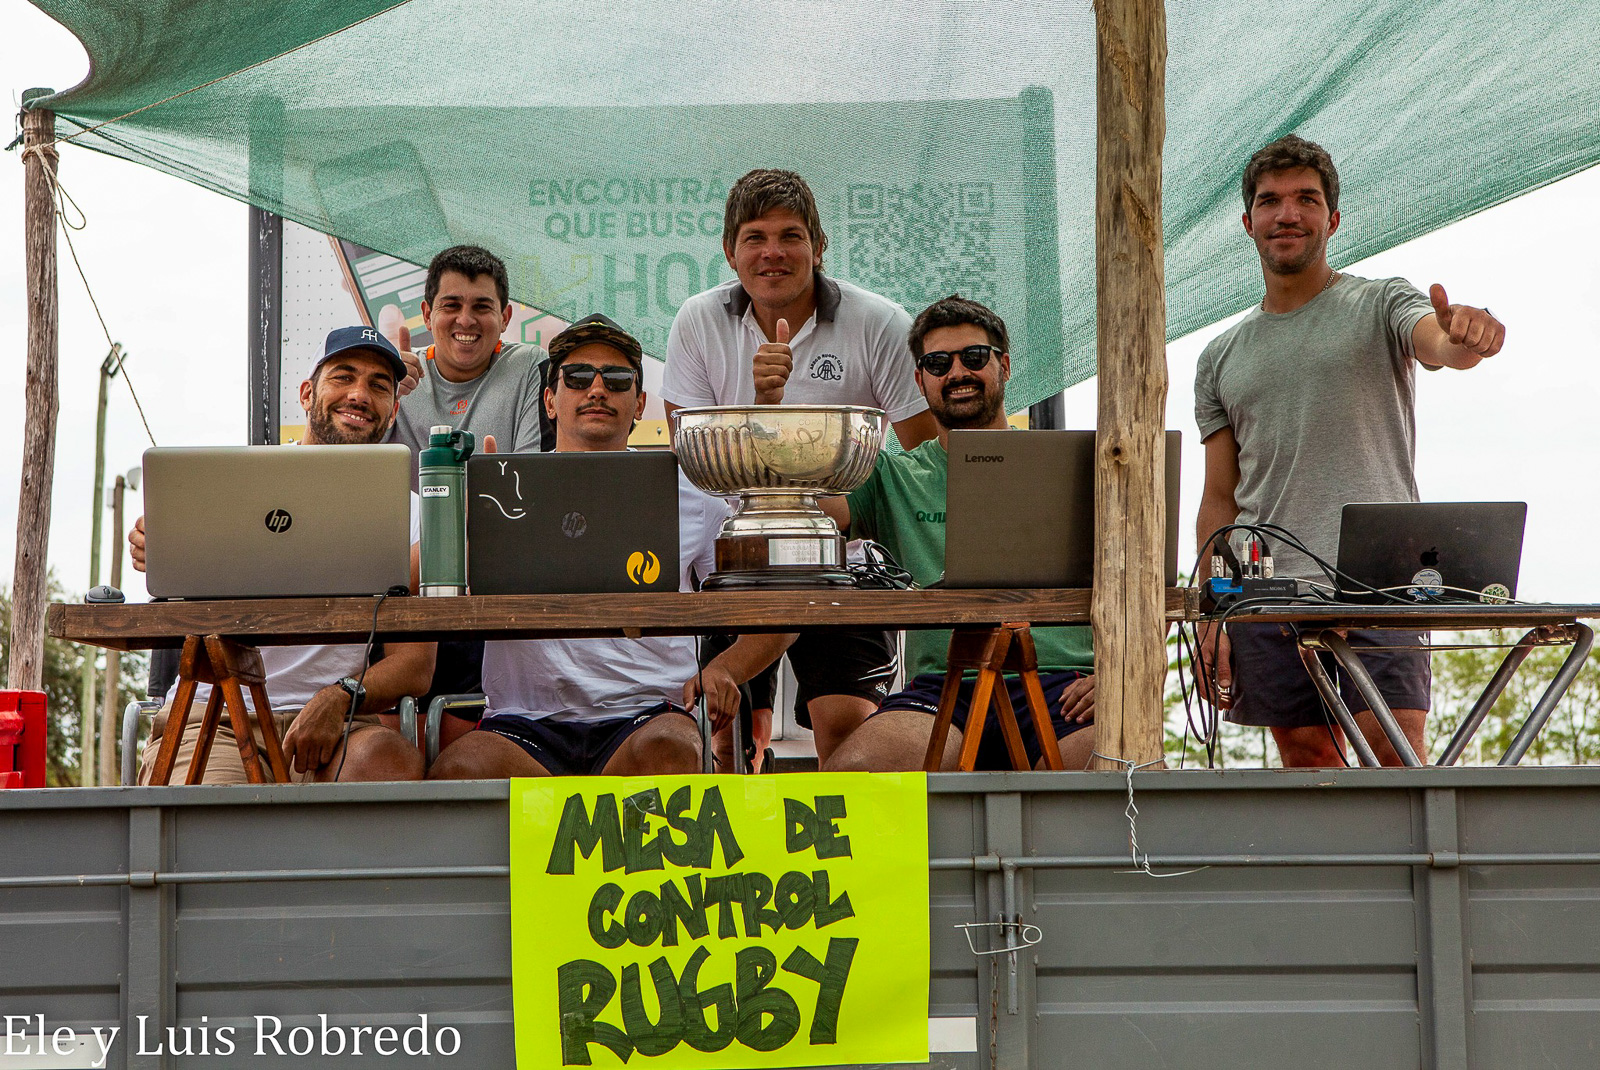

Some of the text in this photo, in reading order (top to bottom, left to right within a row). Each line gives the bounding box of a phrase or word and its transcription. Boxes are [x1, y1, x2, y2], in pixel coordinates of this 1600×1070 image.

[544, 211, 617, 243] QUE
[964, 453, 1005, 463] Lenovo
[267, 509, 290, 533] hp
[546, 784, 853, 875] MESA DE
[587, 869, 855, 949] CONTROL
[556, 937, 859, 1066] RUGBY
